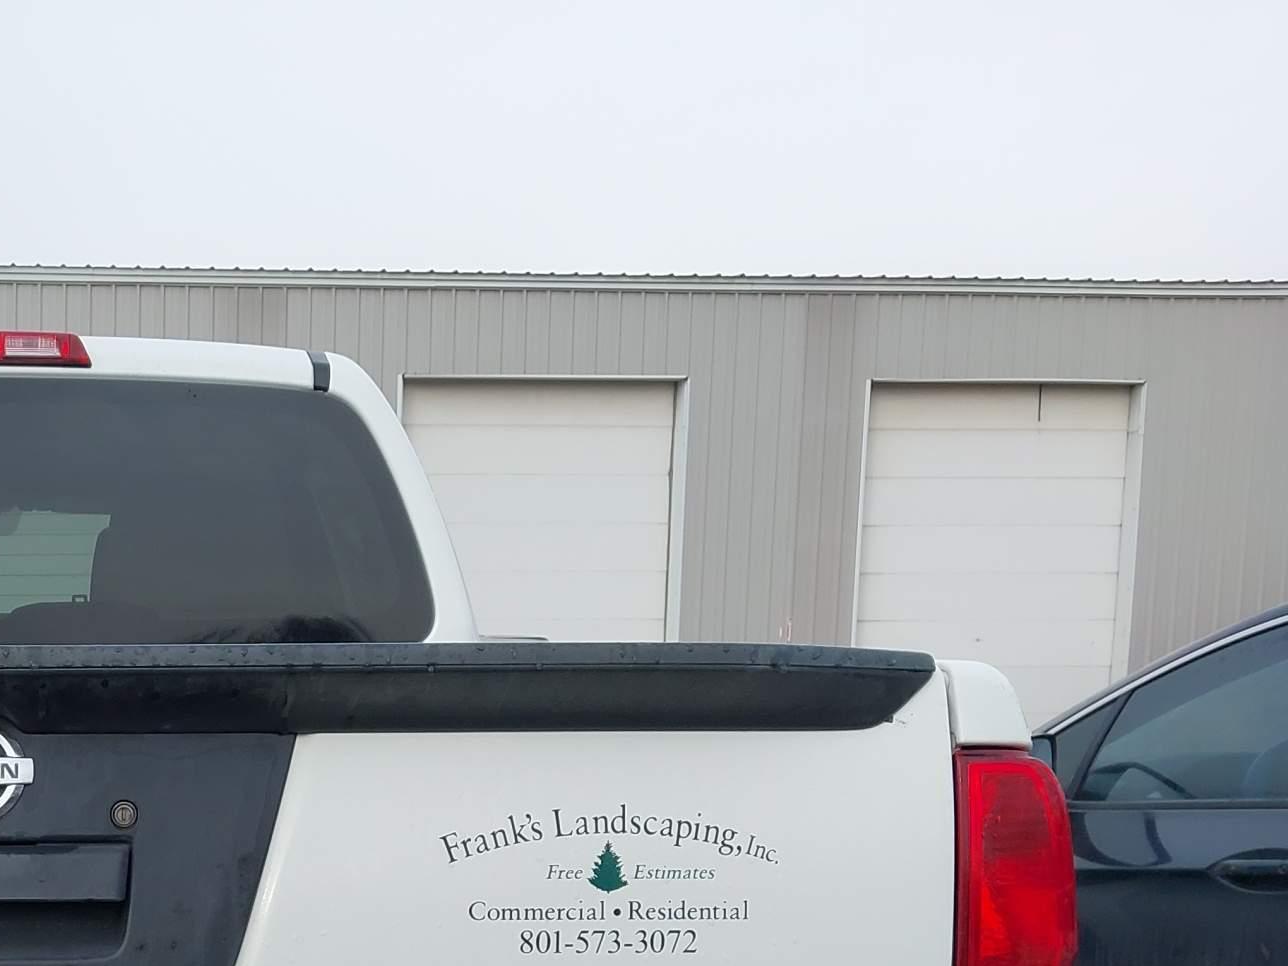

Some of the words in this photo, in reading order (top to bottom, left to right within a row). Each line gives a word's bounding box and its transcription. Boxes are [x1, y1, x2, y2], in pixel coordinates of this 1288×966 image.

[439, 813, 543, 864] Frank's
[551, 803, 742, 857] Landscaping,
[745, 834, 779, 865] Inc.
[546, 864, 584, 880] Free
[633, 864, 716, 880] Estimates
[468, 900, 605, 921] Commercial
[628, 900, 748, 921] Residential
[519, 929, 697, 954] 801-573-3072
